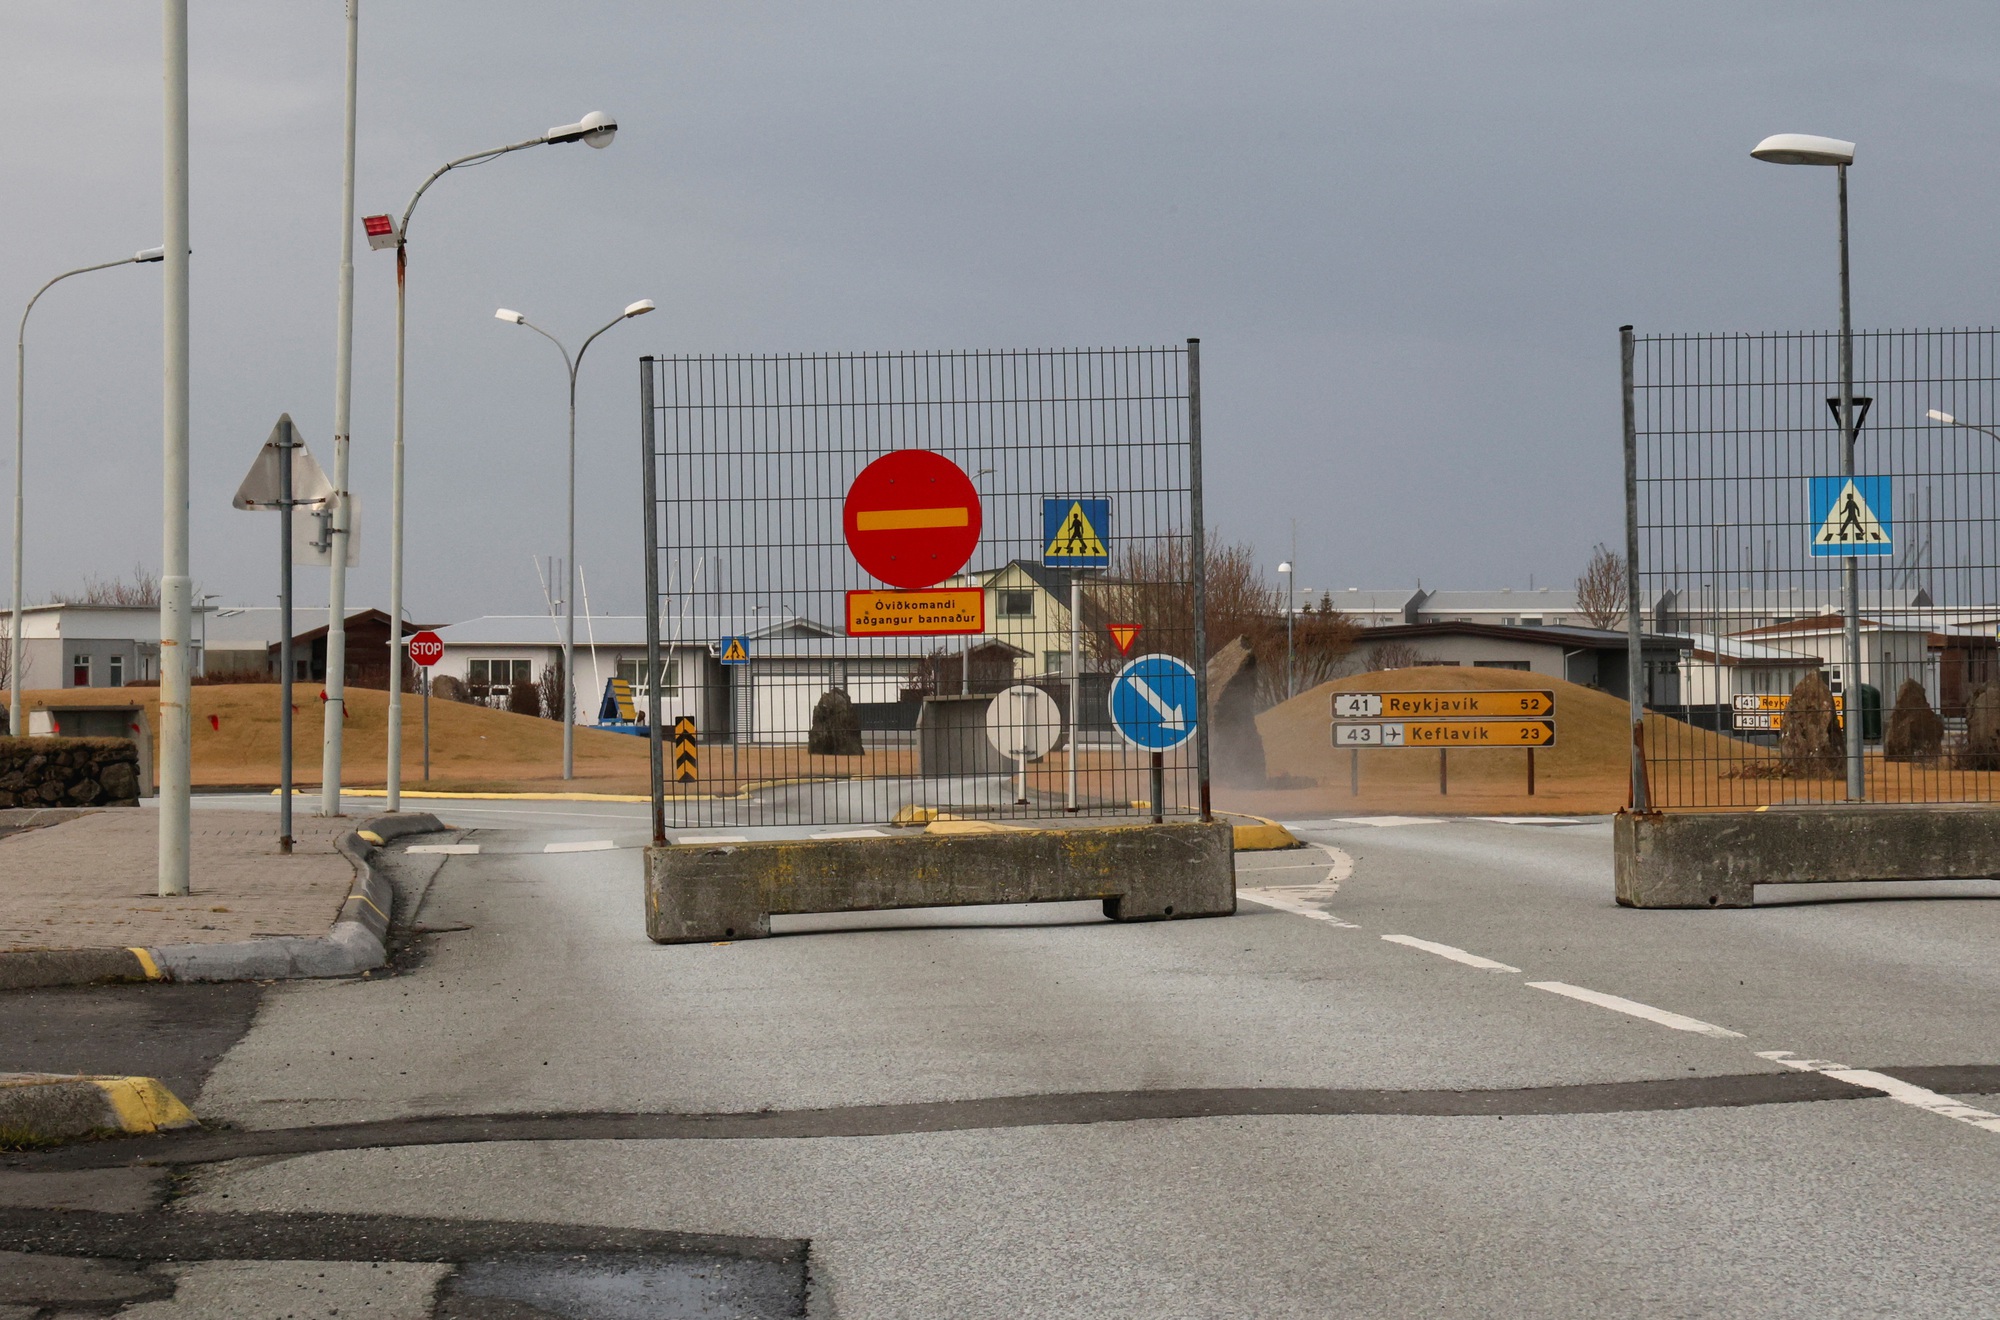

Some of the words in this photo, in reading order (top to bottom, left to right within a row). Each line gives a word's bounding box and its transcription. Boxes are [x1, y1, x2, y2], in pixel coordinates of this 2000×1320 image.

[875, 599, 955, 611] Óviðkomandi
[855, 615, 913, 626] aðgangur
[918, 613, 976, 623] bannaður
[411, 641, 441, 655] STOP
[1349, 699, 1369, 712] 41
[1390, 697, 1479, 713] Reykjavík
[1520, 698, 1539, 710] 52
[1743, 698, 1753, 706] 41
[1743, 717, 1754, 725] 43
[1347, 728, 1371, 741] 43
[1412, 727, 1488, 740] Keflavík
[1520, 728, 1540, 739] 23
